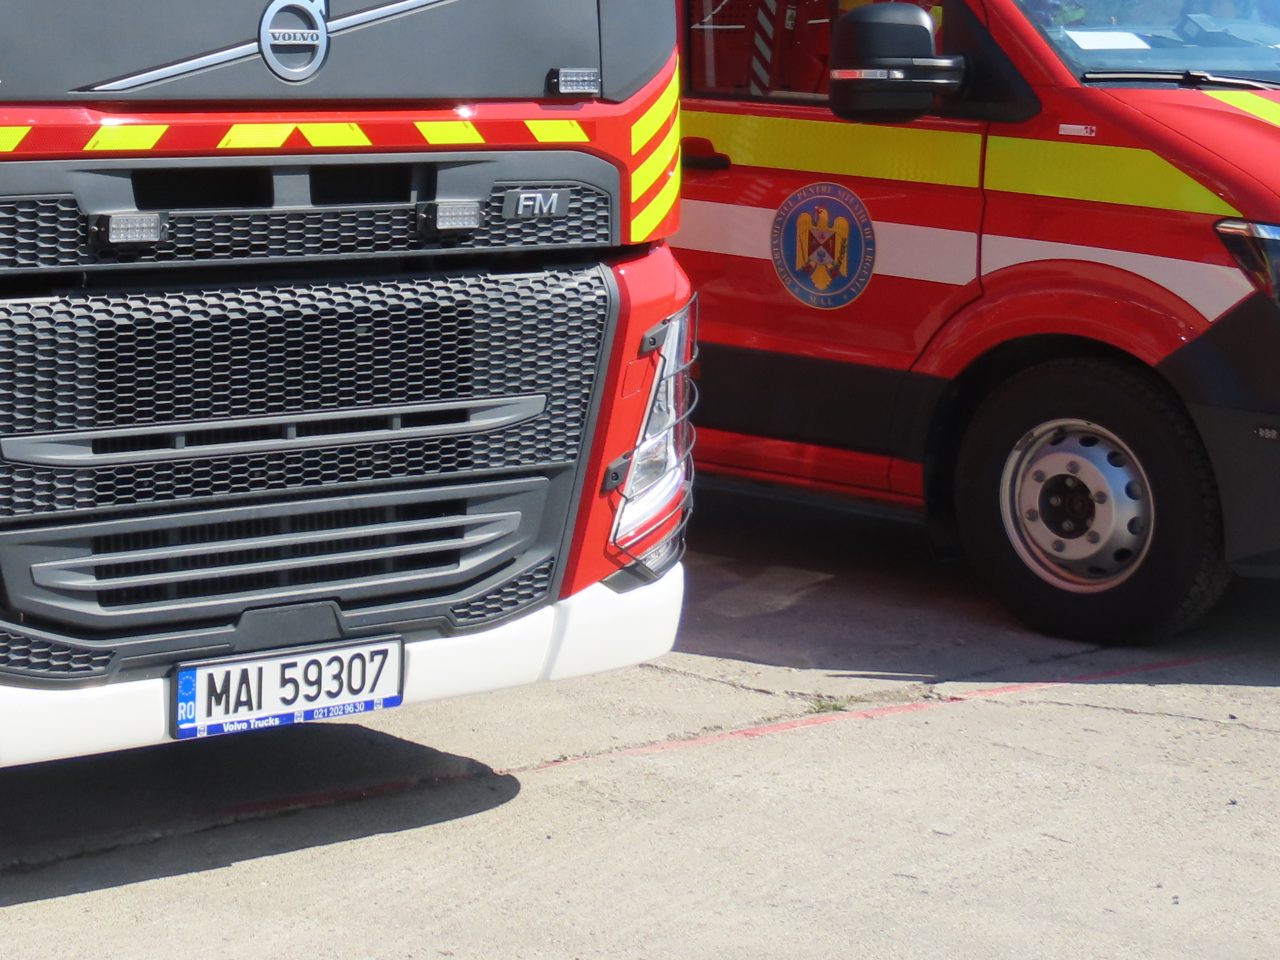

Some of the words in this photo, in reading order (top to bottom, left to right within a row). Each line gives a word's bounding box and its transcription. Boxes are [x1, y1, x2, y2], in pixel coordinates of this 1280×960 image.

[270, 32, 320, 42] VOLVO
[517, 192, 559, 214] FM
[206, 666, 263, 718] MAI
[279, 648, 389, 706] 59307
[178, 701, 195, 721] RO
[223, 722, 248, 732] Volvo
[249, 717, 280, 729] Trucks
[313, 707, 328, 719] 021
[329, 705, 343, 717] 202
[344, 703, 354, 714] 96
[355, 702, 365, 712] 30
